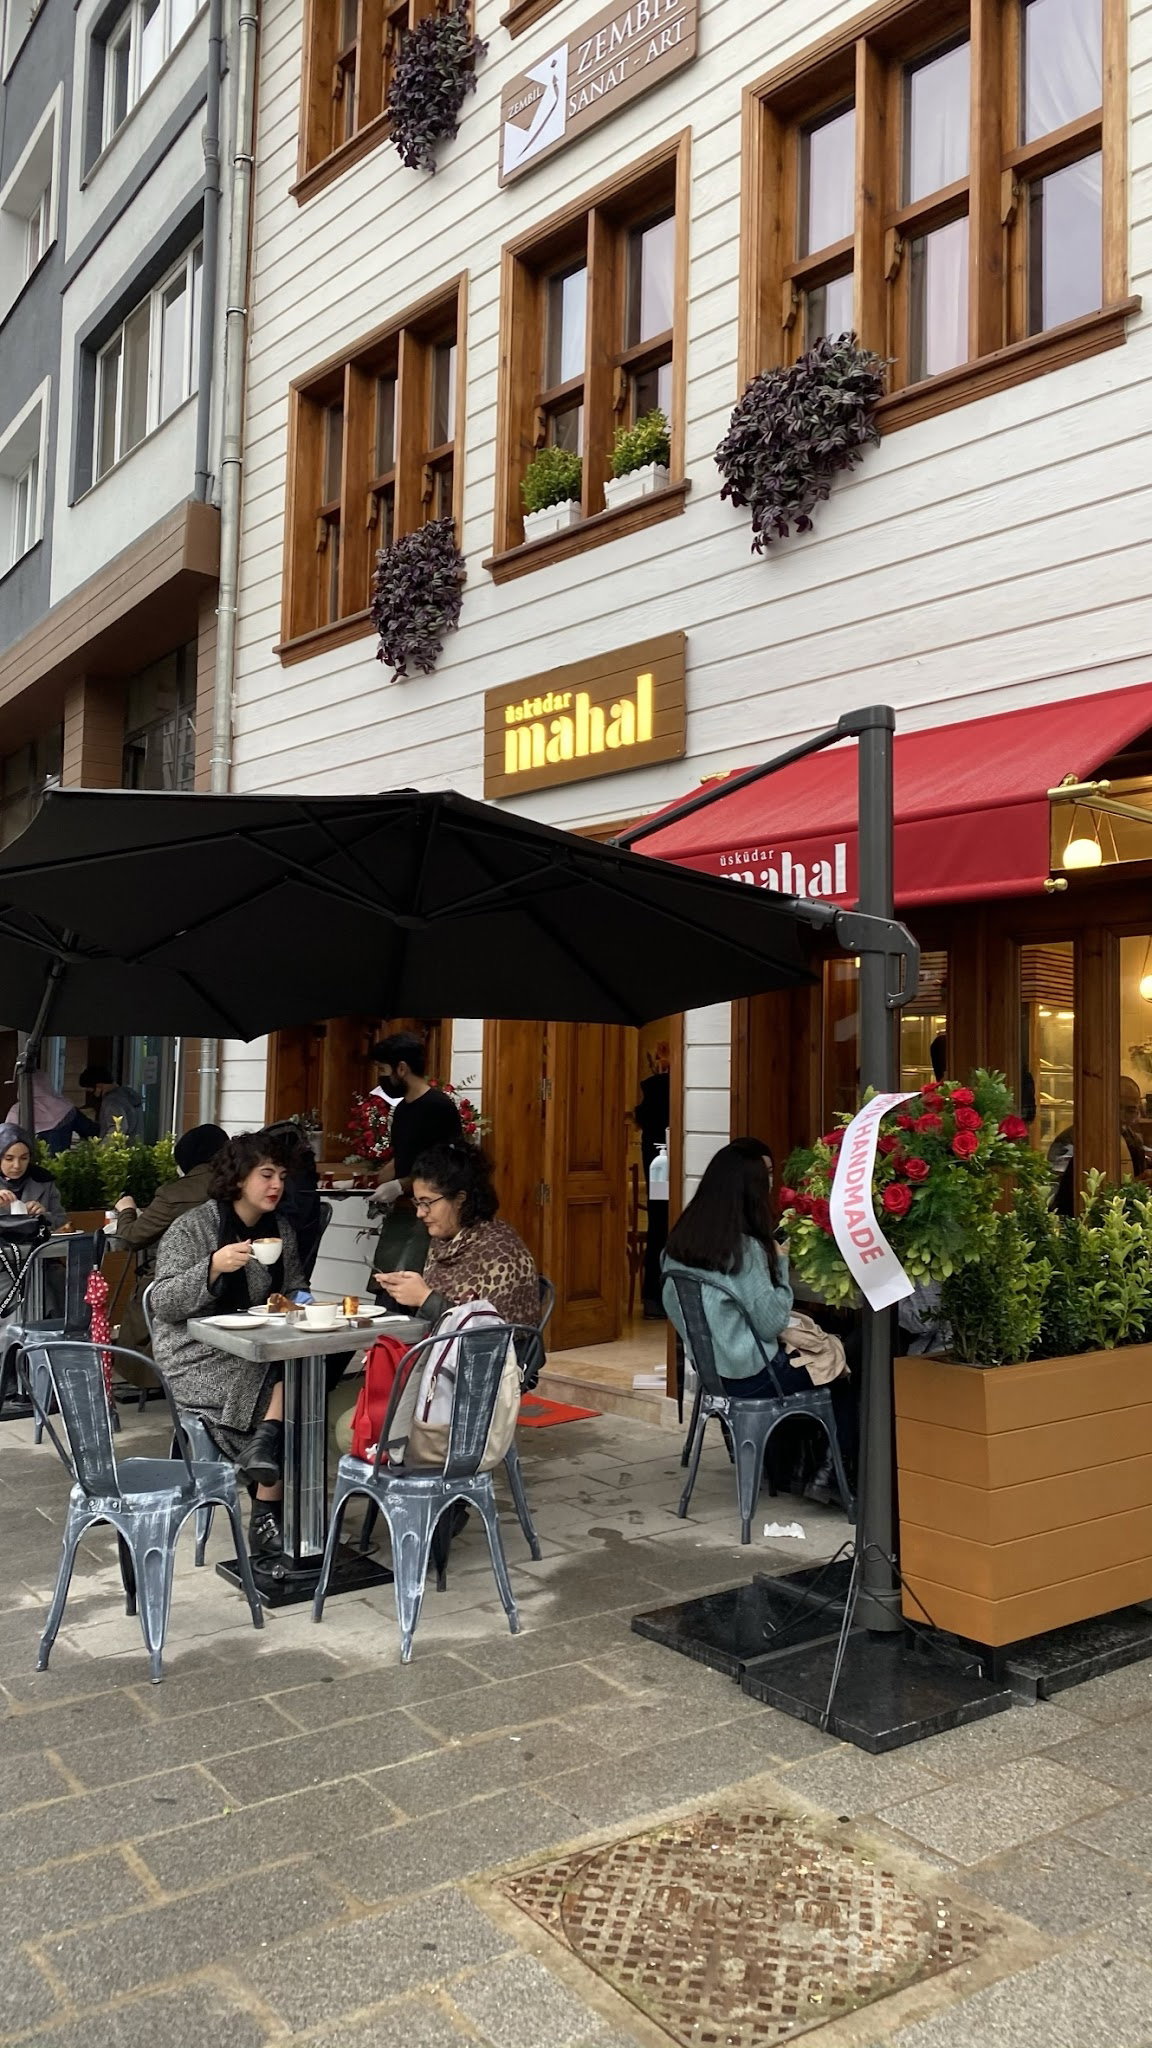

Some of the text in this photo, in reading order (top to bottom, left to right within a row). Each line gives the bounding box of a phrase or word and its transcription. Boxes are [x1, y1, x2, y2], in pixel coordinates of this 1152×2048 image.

[508, 87, 542, 118] ZEMBIL
[568, 57, 629, 117] SANAT
[645, 17, 685, 66] ART
[504, 673, 653, 774] mahal
[719, 843, 847, 898] ahal
[720, 849, 775, 867] üsküdar
[843, 1122, 885, 1264] HANDMADE
